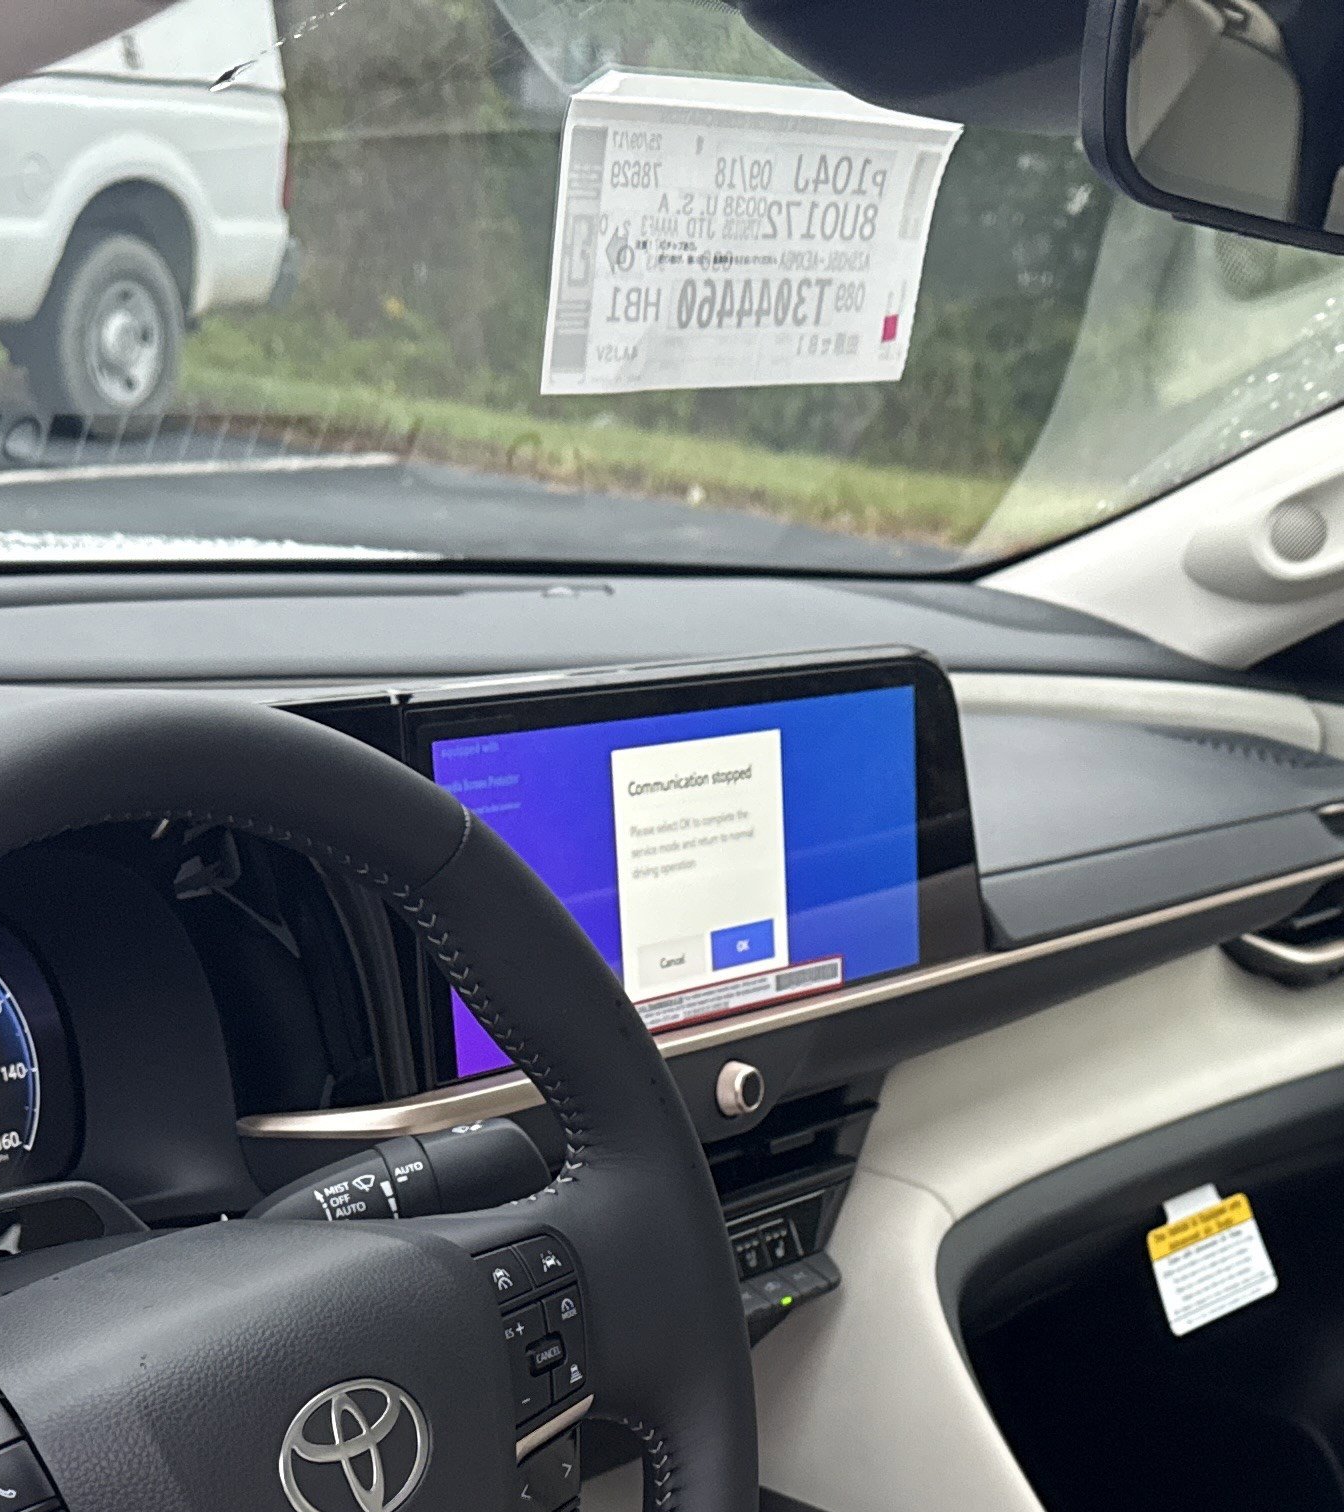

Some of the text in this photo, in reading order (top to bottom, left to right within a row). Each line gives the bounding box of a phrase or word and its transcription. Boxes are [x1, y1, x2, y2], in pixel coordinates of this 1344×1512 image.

[628, 763, 752, 797] Communication stopped
[630, 826, 654, 838] Please
[657, 820, 678, 834] select
[702, 813, 734, 827] complete
[632, 847, 656, 858] service
[660, 841, 680, 853] mode
[682, 839, 696, 850] and
[698, 836, 718, 847] return
[730, 828, 754, 840] normal
[632, 867, 659, 879] driving
[736, 938, 750, 952] OK
[660, 952, 686, 970] Cancel
[0, 1062, 26, 1082] 140
[394, 1161, 424, 1178] AUTO
[324, 1182, 350, 1198] MIST
[330, 1193, 352, 1208] OFF
[335, 1201, 366, 1219] AUTO
[536, 1346, 561, 1365] CANCEL
